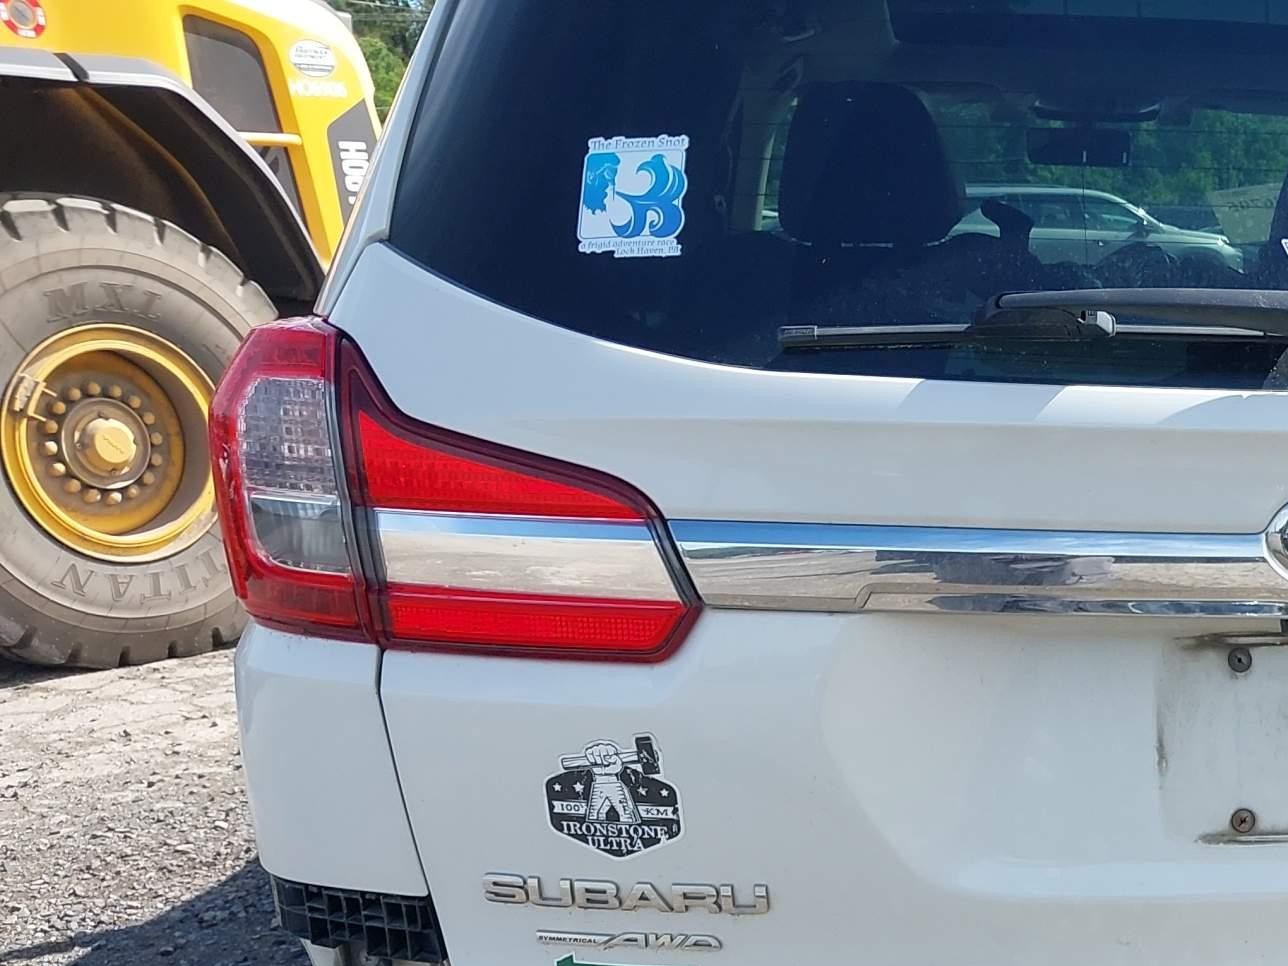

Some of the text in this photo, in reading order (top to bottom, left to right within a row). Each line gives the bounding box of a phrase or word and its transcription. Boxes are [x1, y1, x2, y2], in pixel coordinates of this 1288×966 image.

[591, 136, 687, 151] The Frozen Snot
[612, 238, 655, 248] adventure
[51, 549, 226, 605] TITAN
[646, 808, 669, 817] KM
[561, 821, 668, 839] IRONSTONE
[586, 836, 644, 851] ULTRA
[481, 872, 772, 917] SUBARU
[537, 930, 725, 952] SYMMETRICAL AWD
